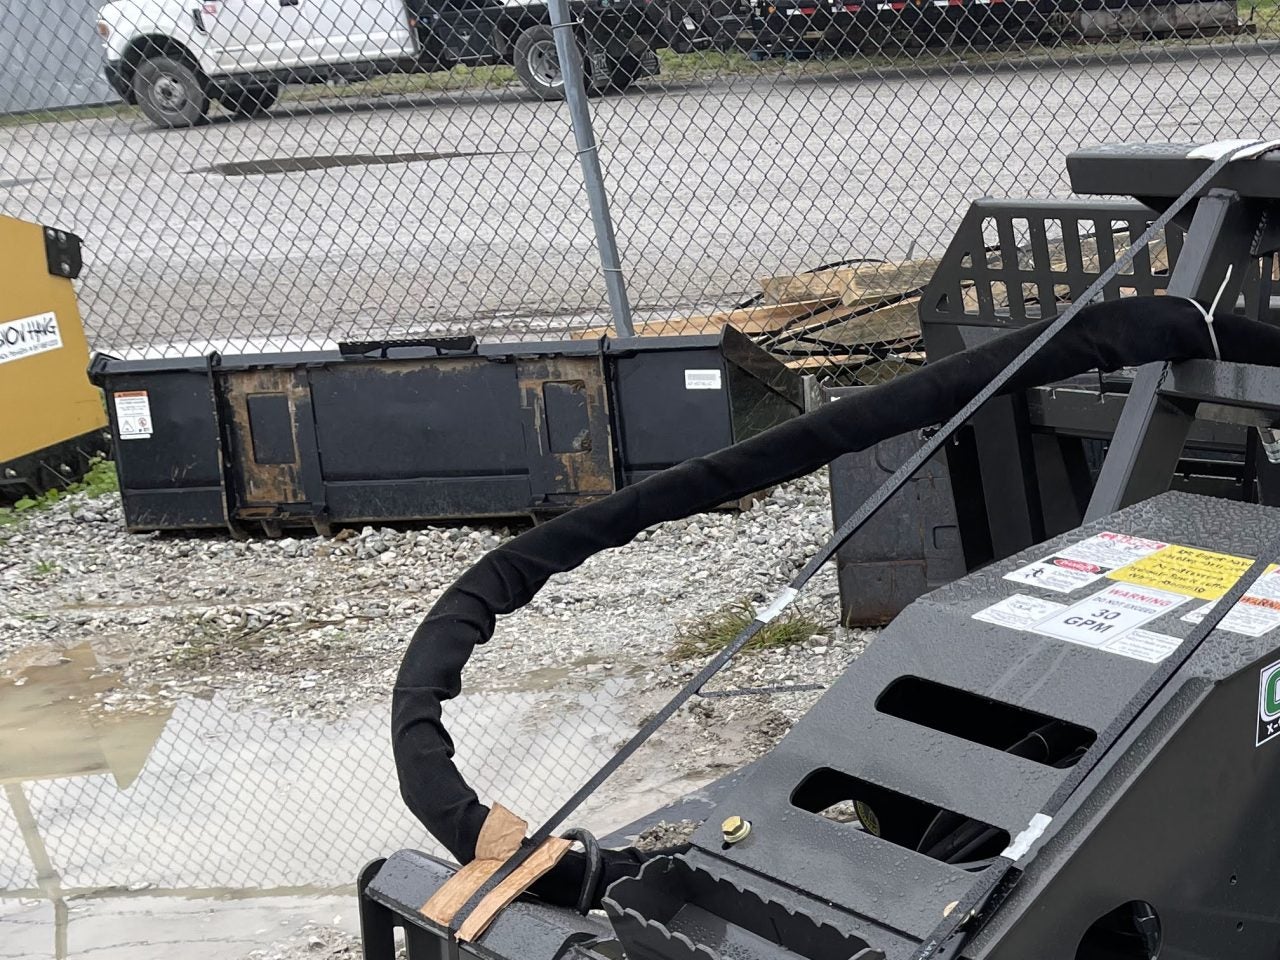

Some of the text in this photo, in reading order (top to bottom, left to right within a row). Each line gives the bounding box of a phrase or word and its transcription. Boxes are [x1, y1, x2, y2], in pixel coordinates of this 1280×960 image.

[1108, 588, 1172, 607] WARNING
[1091, 608, 1121, 620] 30
[1106, 599, 1123, 607] NOT
[1124, 602, 1157, 615] EXCEED
[1063, 616, 1114, 633] GPM
